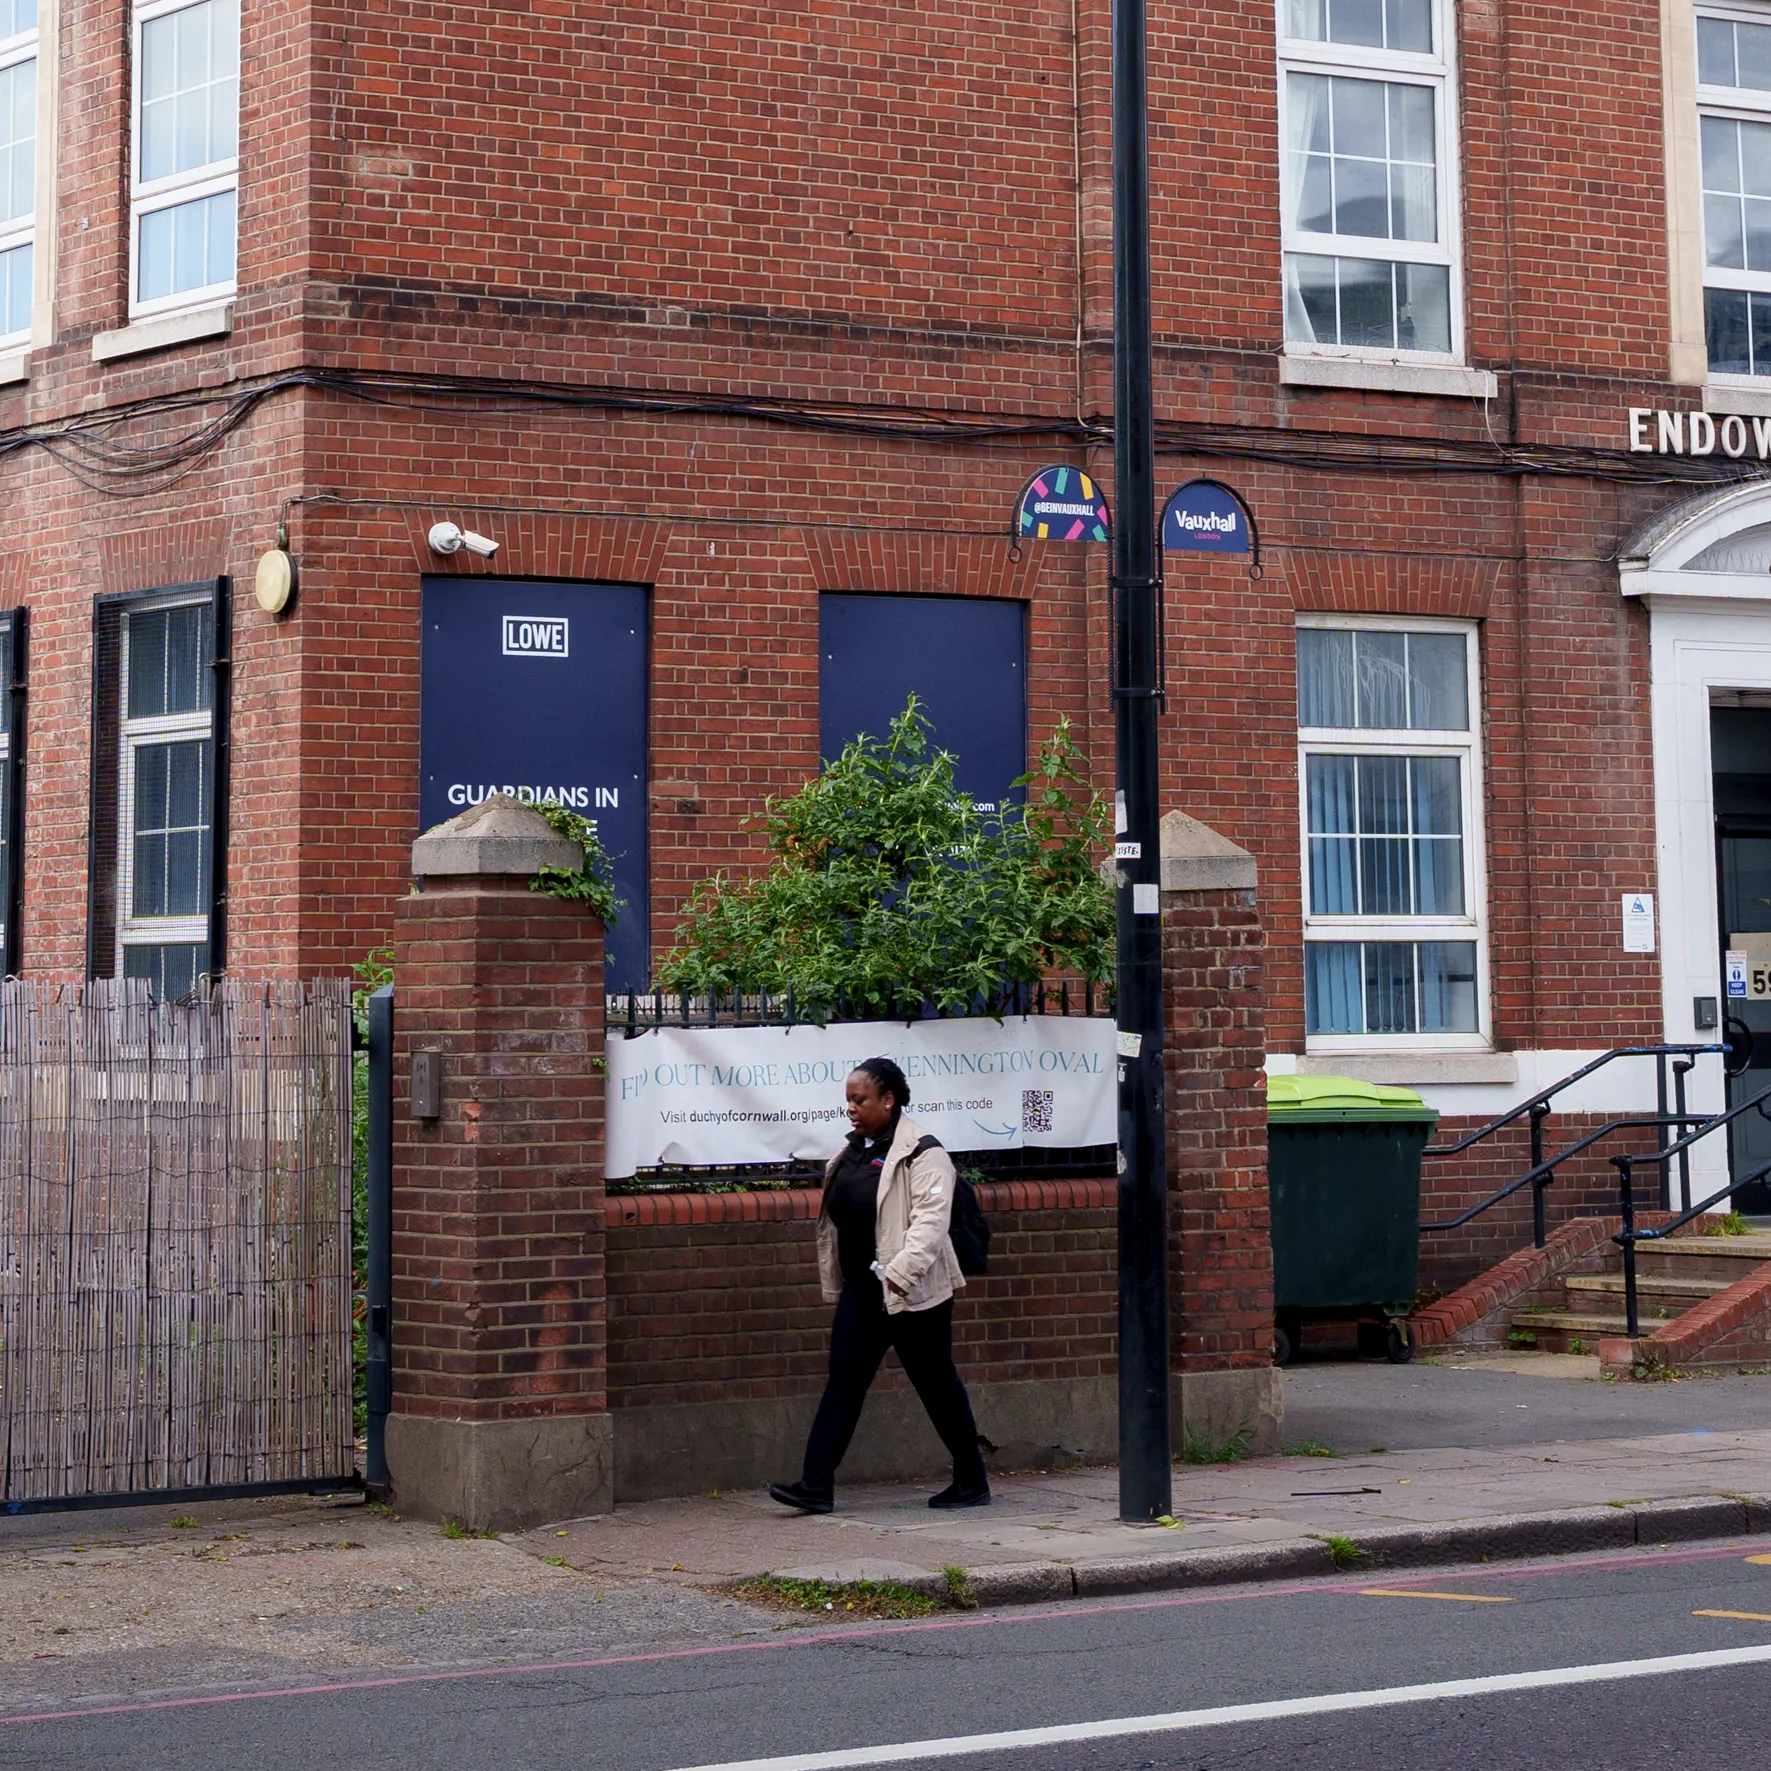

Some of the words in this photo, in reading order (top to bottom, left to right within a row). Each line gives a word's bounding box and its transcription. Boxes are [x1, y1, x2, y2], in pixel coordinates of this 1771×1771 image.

[1034, 501, 1095, 517] @BEINVAUXHALL
[1175, 510, 1236, 532] Vauxhall
[1194, 532, 1221, 540] LONDON
[508, 623, 563, 649] LOWE
[447, 784, 589, 808] GUARDIANS
[595, 788, 619, 808] IN
[654, 1063, 706, 1086] OUT
[711, 1064, 779, 1087] MORE
[1039, 1050, 1104, 1074] OVAL
[660, 1110, 687, 1124] Visit
[917, 1101, 945, 1113] scan
[946, 1098, 963, 1111] this
[966, 1097, 993, 1110] code
